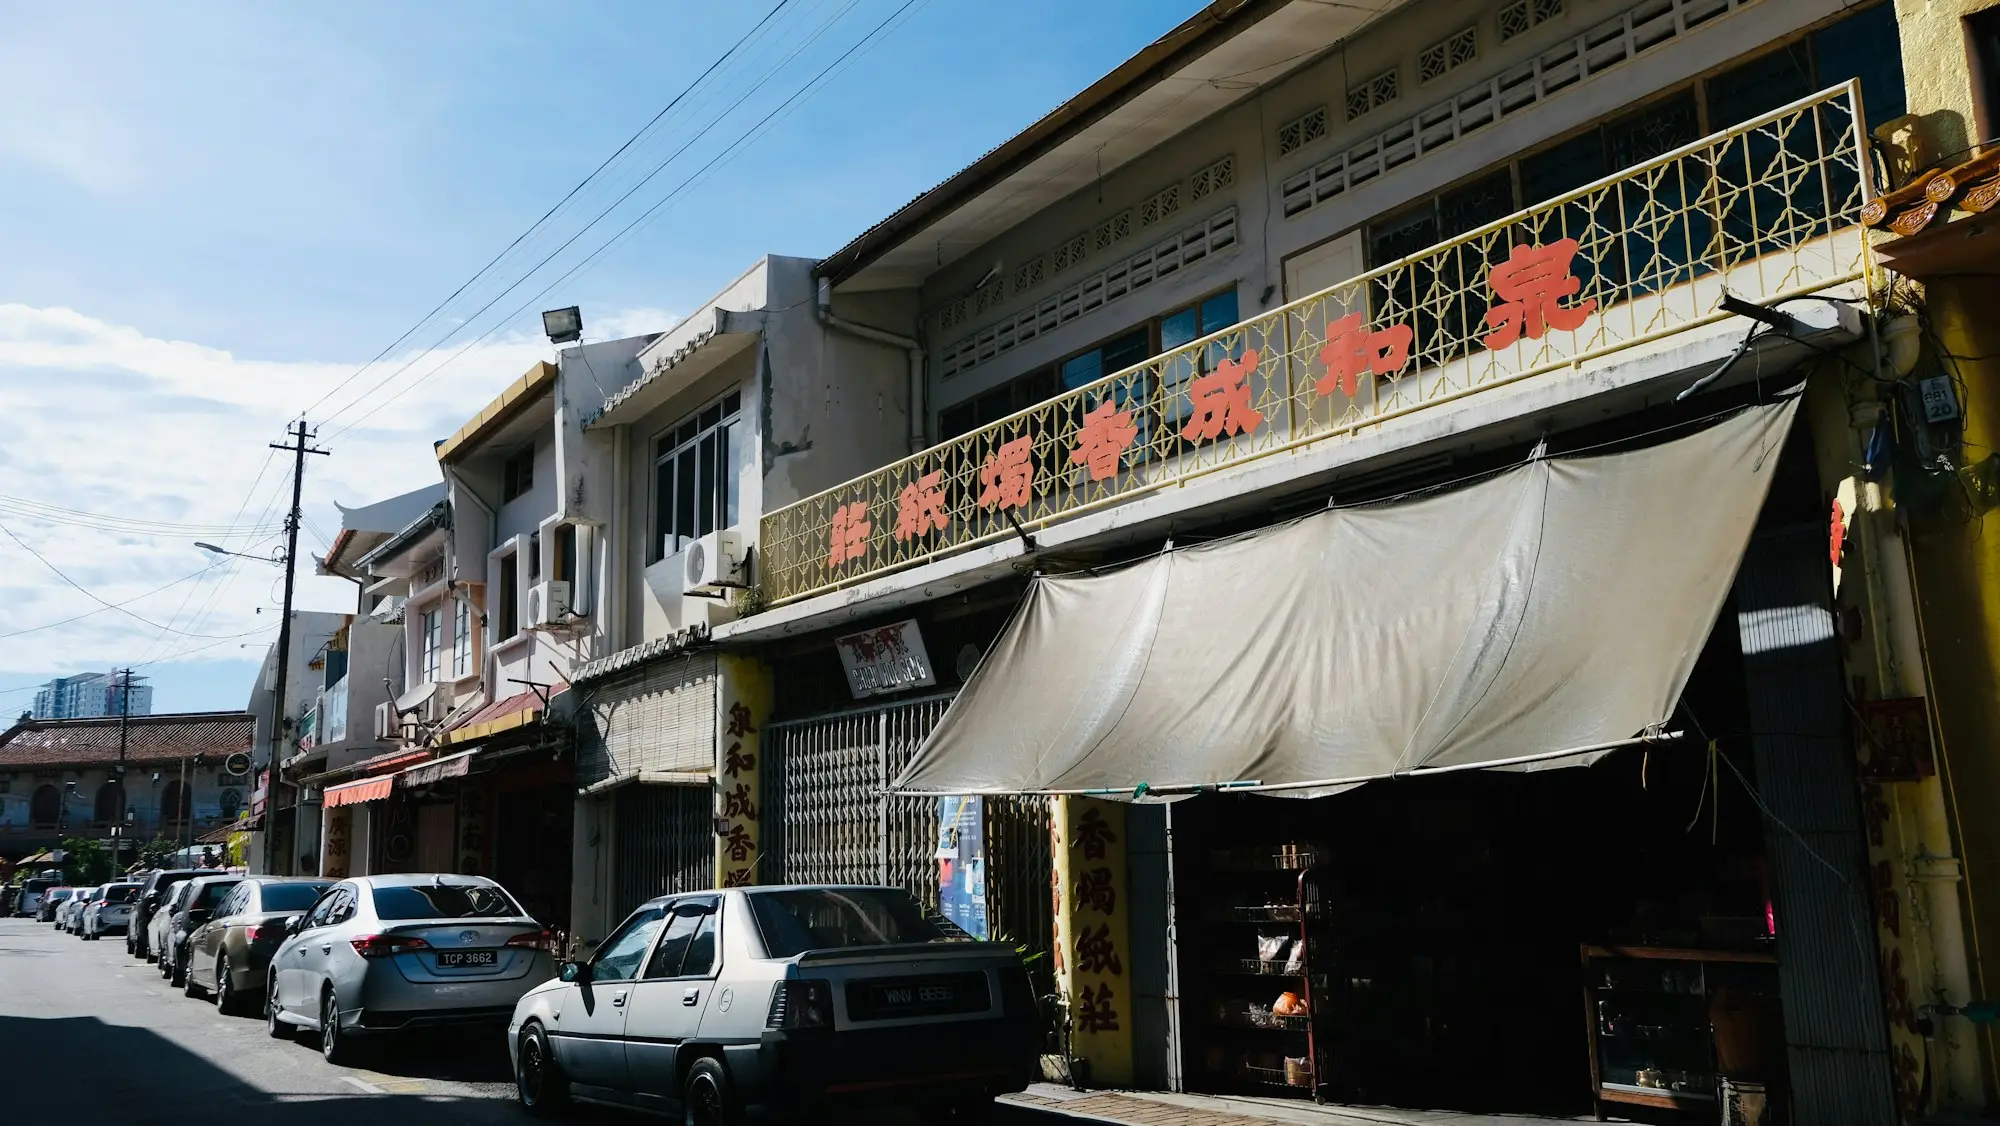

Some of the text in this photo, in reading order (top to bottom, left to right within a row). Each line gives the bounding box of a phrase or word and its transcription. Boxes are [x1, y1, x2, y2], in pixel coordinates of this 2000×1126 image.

[1930, 404, 1952, 418] 20
[901, 655, 927, 682] SENG
[443, 952, 492, 964] TCP 3662
